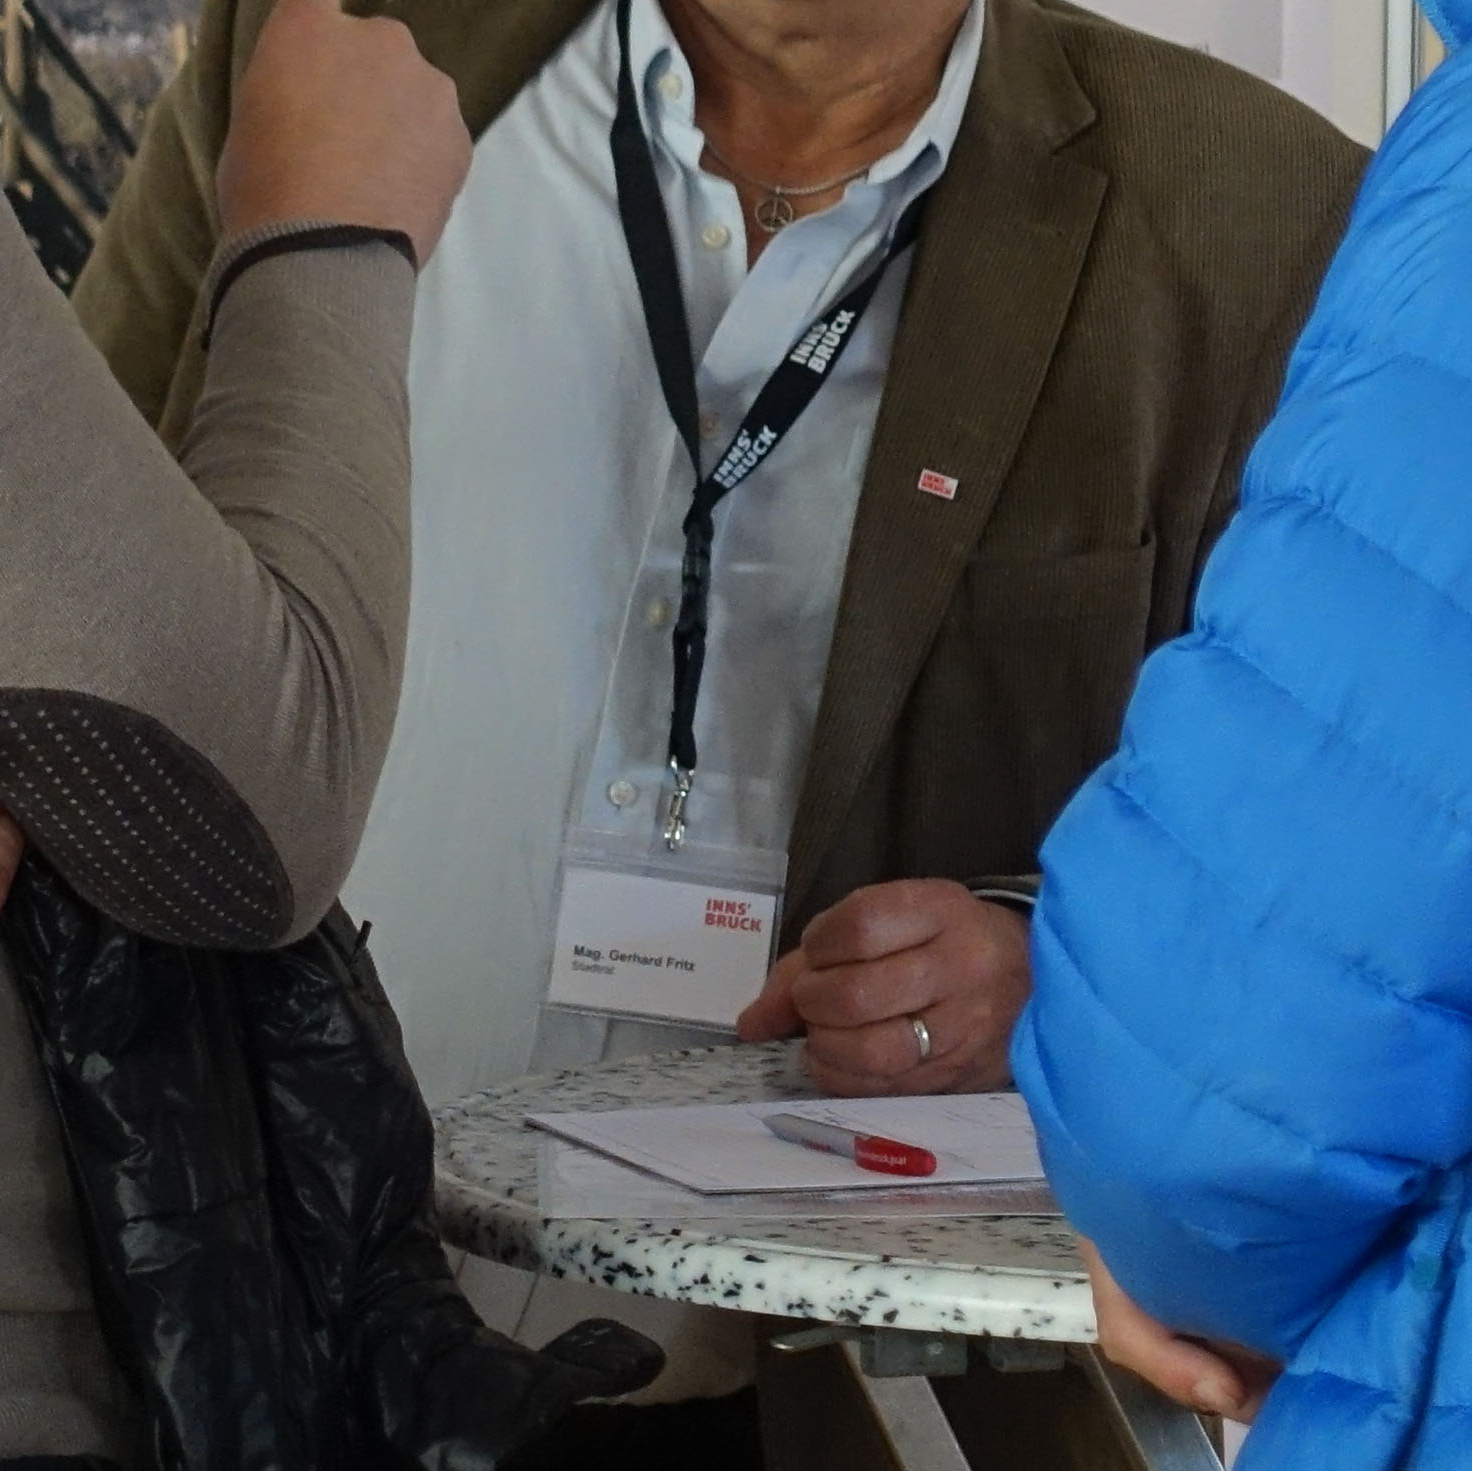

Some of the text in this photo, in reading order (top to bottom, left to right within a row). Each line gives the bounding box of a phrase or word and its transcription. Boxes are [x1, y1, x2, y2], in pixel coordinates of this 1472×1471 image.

[808, 310, 856, 374] BRUCK
[706, 898, 751, 915] INNS'
[705, 913, 762, 932] BRUCK
[609, 949, 663, 967] Gerhard
[666, 957, 695, 971] Fritz
